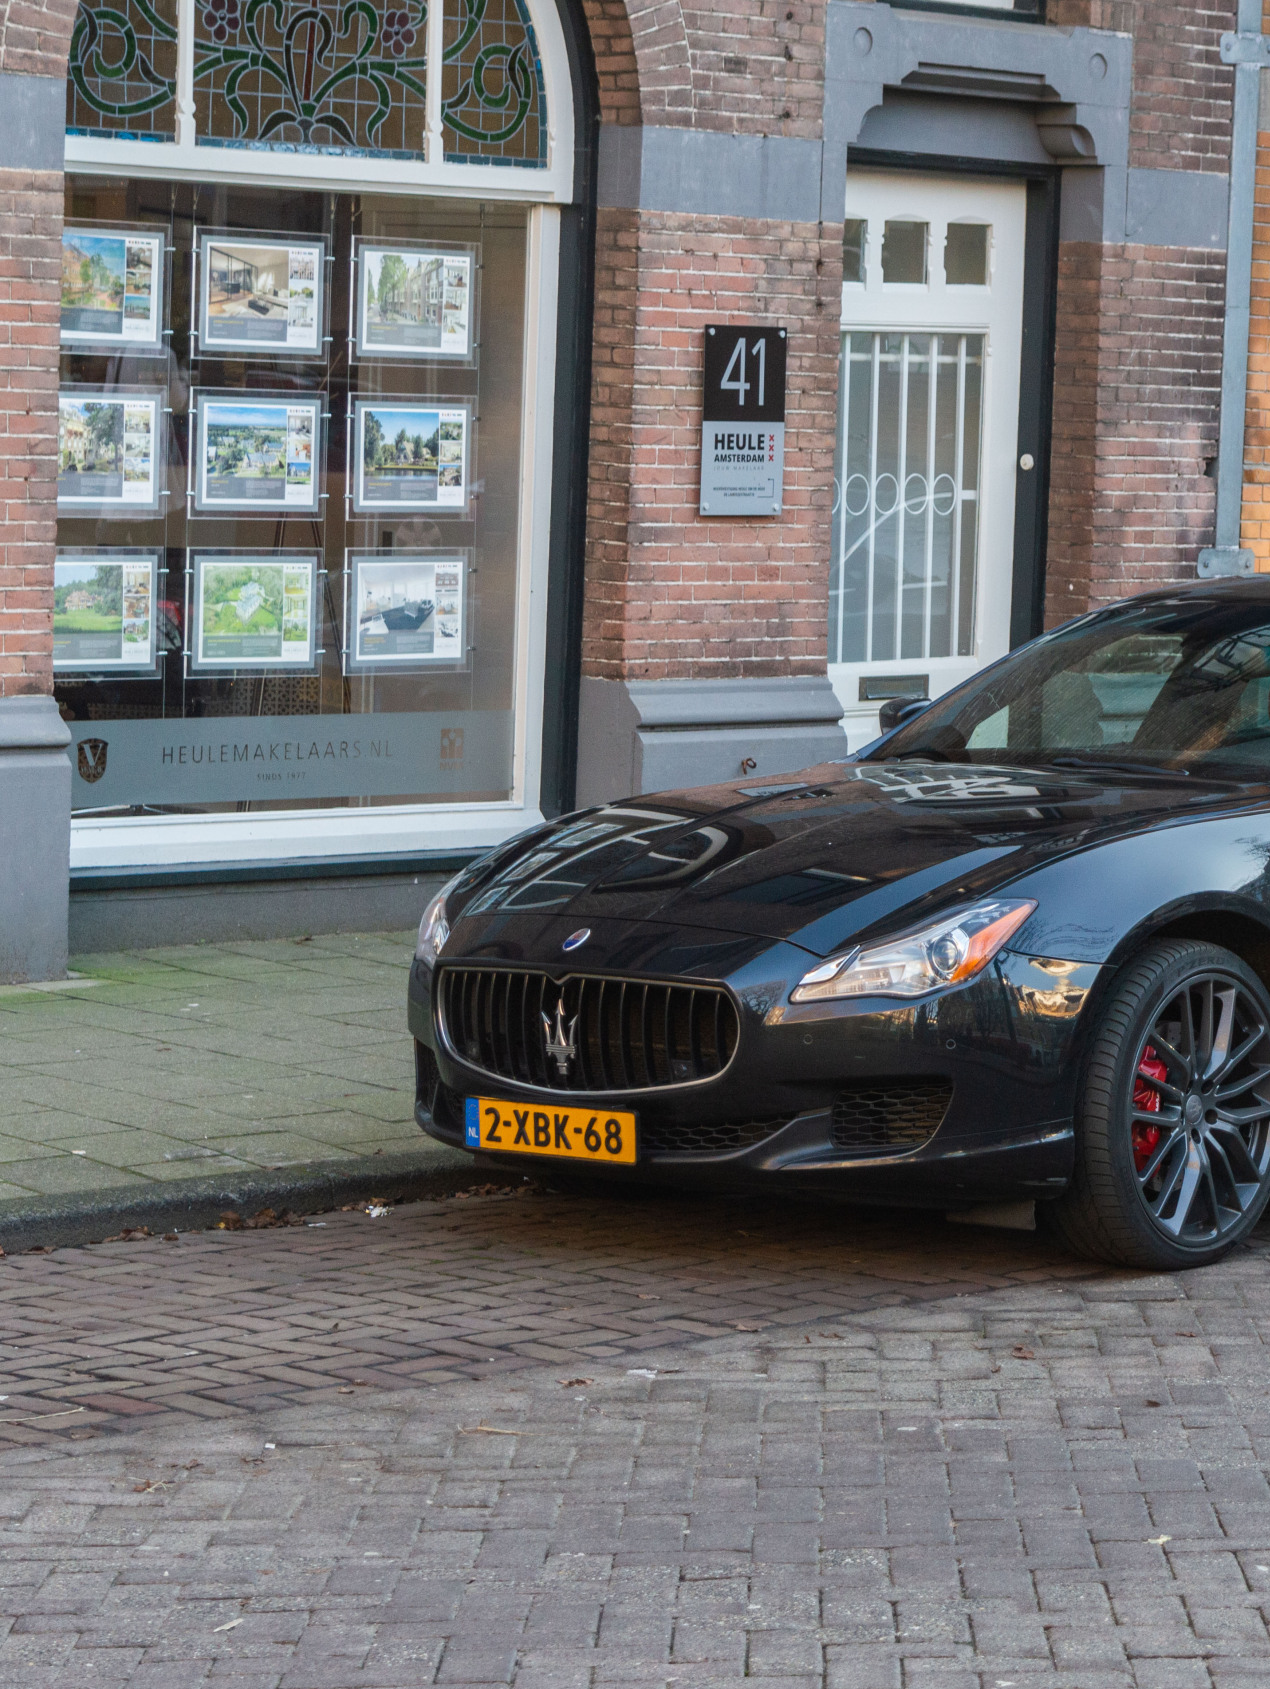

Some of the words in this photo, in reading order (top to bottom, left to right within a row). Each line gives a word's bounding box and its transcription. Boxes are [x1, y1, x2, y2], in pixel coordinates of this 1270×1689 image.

[720, 337, 766, 406] 41
[714, 433, 765, 450] HEULE
[714, 454, 765, 463] AMSTERDAM
[162, 740, 394, 764] HEULEMAKELAARS.NL
[257, 773, 282, 781] SINDS
[468, 1127, 478, 1138] NL
[485, 1107, 622, 1154] 2-XBK-68
